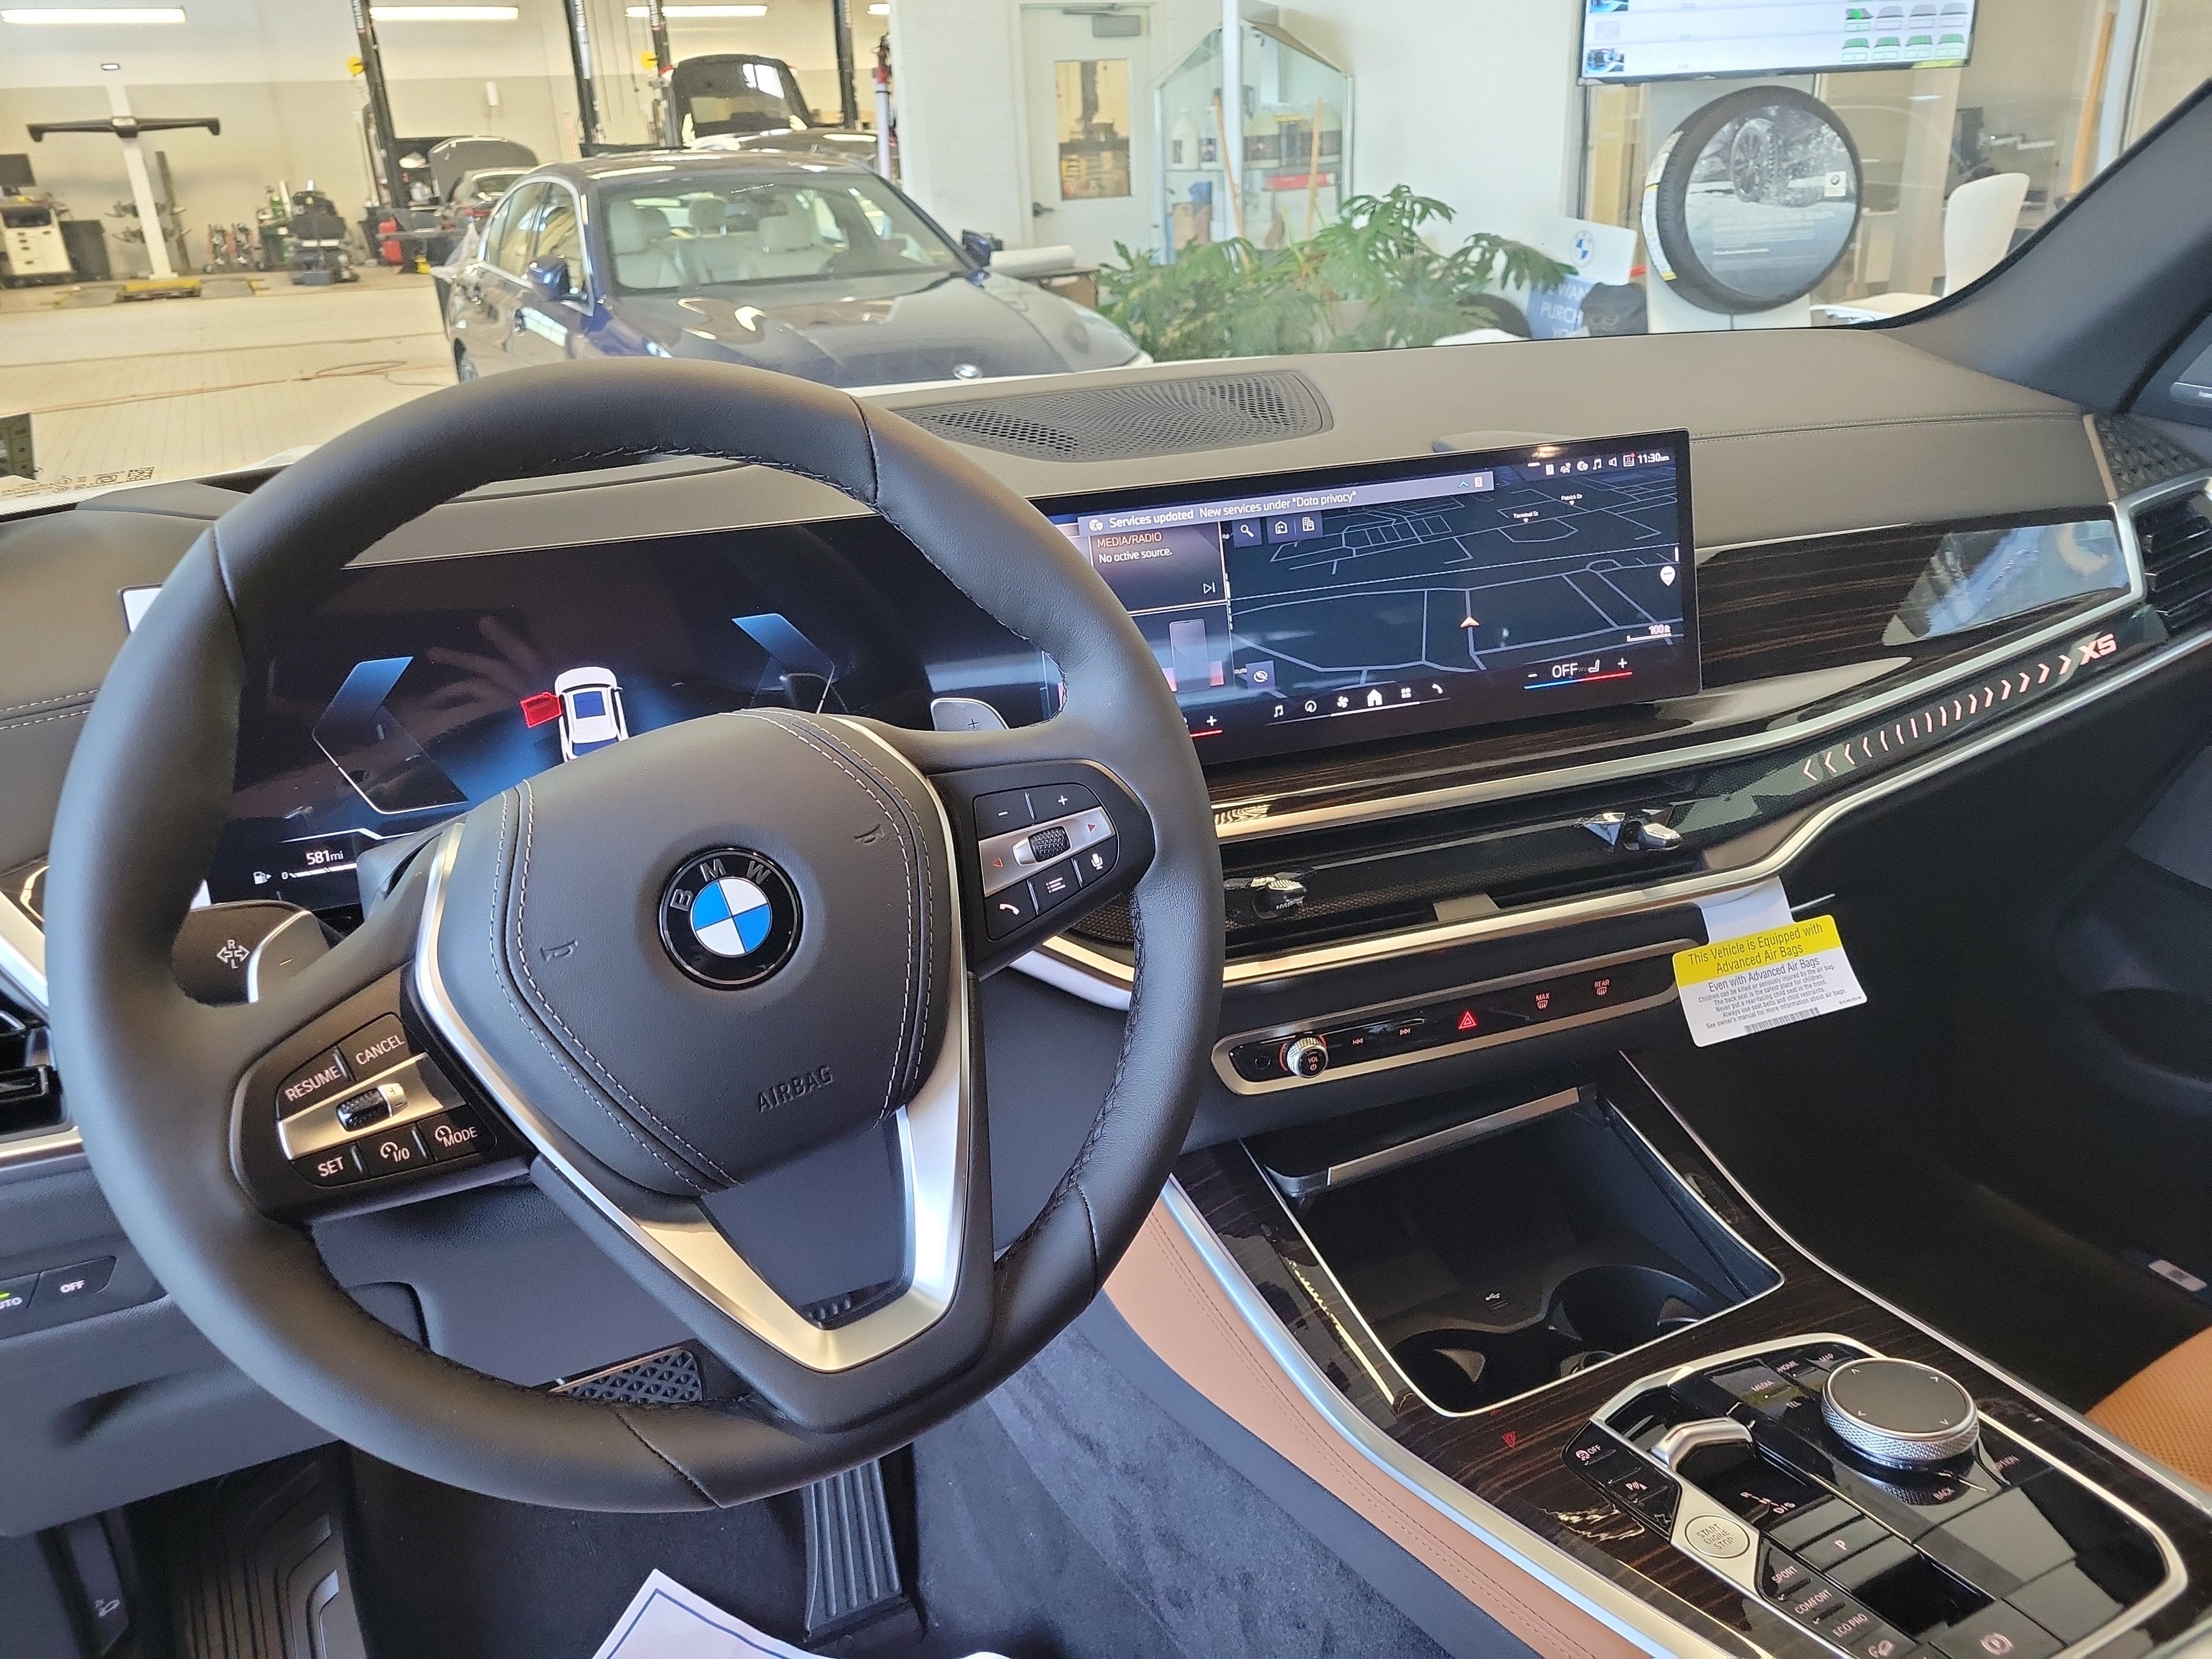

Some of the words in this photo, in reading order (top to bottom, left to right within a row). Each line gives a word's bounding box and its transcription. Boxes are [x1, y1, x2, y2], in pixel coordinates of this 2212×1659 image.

[1109, 515, 1152, 528] Services
[1153, 509, 1194, 524] updated
[1199, 507, 1221, 518] New
[1223, 503, 1261, 516] services
[1263, 499, 1290, 511] under
[1292, 497, 1318, 507] "Data
[1321, 490, 1356, 506] privacy"
[1097, 532, 1162, 548] MEDIA/RADIO
[1098, 554, 1112, 563] No
[1114, 551, 1139, 561] active
[1142, 548, 1173, 558] source.
[2079, 634, 2117, 665] X5
[1552, 663, 1578, 678] OFF
[670, 859, 771, 912] BMW
[228, 939, 236, 949] R
[1689, 952, 1708, 966] This
[1711, 942, 1745, 960] Vehicle
[1747, 940, 1756, 951] is
[1758, 928, 1801, 949] Equipped
[1803, 923, 1823, 936] with
[231, 959, 239, 969] L
[1717, 952, 1762, 974] Advanced
[1765, 949, 1777, 962] Air
[1780, 944, 1803, 957] Bags
[1708, 980, 1728, 992] Even
[1729, 975, 1747, 987] with
[1748, 964, 1785, 982] Advanced
[1788, 962, 1798, 973] Air
[1799, 958, 1820, 968] Bags
[1780, 982, 1793, 990] place
[1803, 974, 1824, 983] children.
[1595, 979, 1610, 988] REAR
[1699, 993, 1719, 1003] Children
[1759, 978, 1781, 988] seriously
[1783, 973, 1799, 981] injured
[1536, 992, 1550, 1001] MAX
[1732, 1002, 1740, 1010] put
[1746, 994, 1773, 1005] rear-facing
[1717, 1017, 1737, 1026] owner's
[1738, 1012, 1756, 1020] manual
[1780, 998, 1809, 1009] information
[1810, 994, 1824, 1002] about
[1723, 1009, 1741, 1018] Always
[1787, 992, 1799, 1001] child
[356, 1034, 405, 1065] CANCEL
[285, 1066, 341, 1102] RESUME
[757, 1065, 834, 1113] AIRBAG
[442, 1126, 478, 1148] MODE
[318, 1156, 345, 1177] SET
[60, 1280, 85, 1293] OFF
[0, 1297, 22, 1309] UTO
[1776, 1360, 1799, 1373] HOME
[1751, 1380, 1774, 1392] MEDIA
[1587, 1444, 1601, 1454] OFF
[1697, 1523, 1721, 1538] START
[1703, 1530, 1730, 1545] ENGINE
[1714, 1537, 1734, 1550] STOP
[1835, 1540, 1847, 1551] P
[1771, 1565, 1798, 1584] SPORT
[1795, 1589, 1832, 1615] COMFORT
[1832, 1622, 1852, 1638] ECO
[1851, 1613, 1868, 1628] PRO
